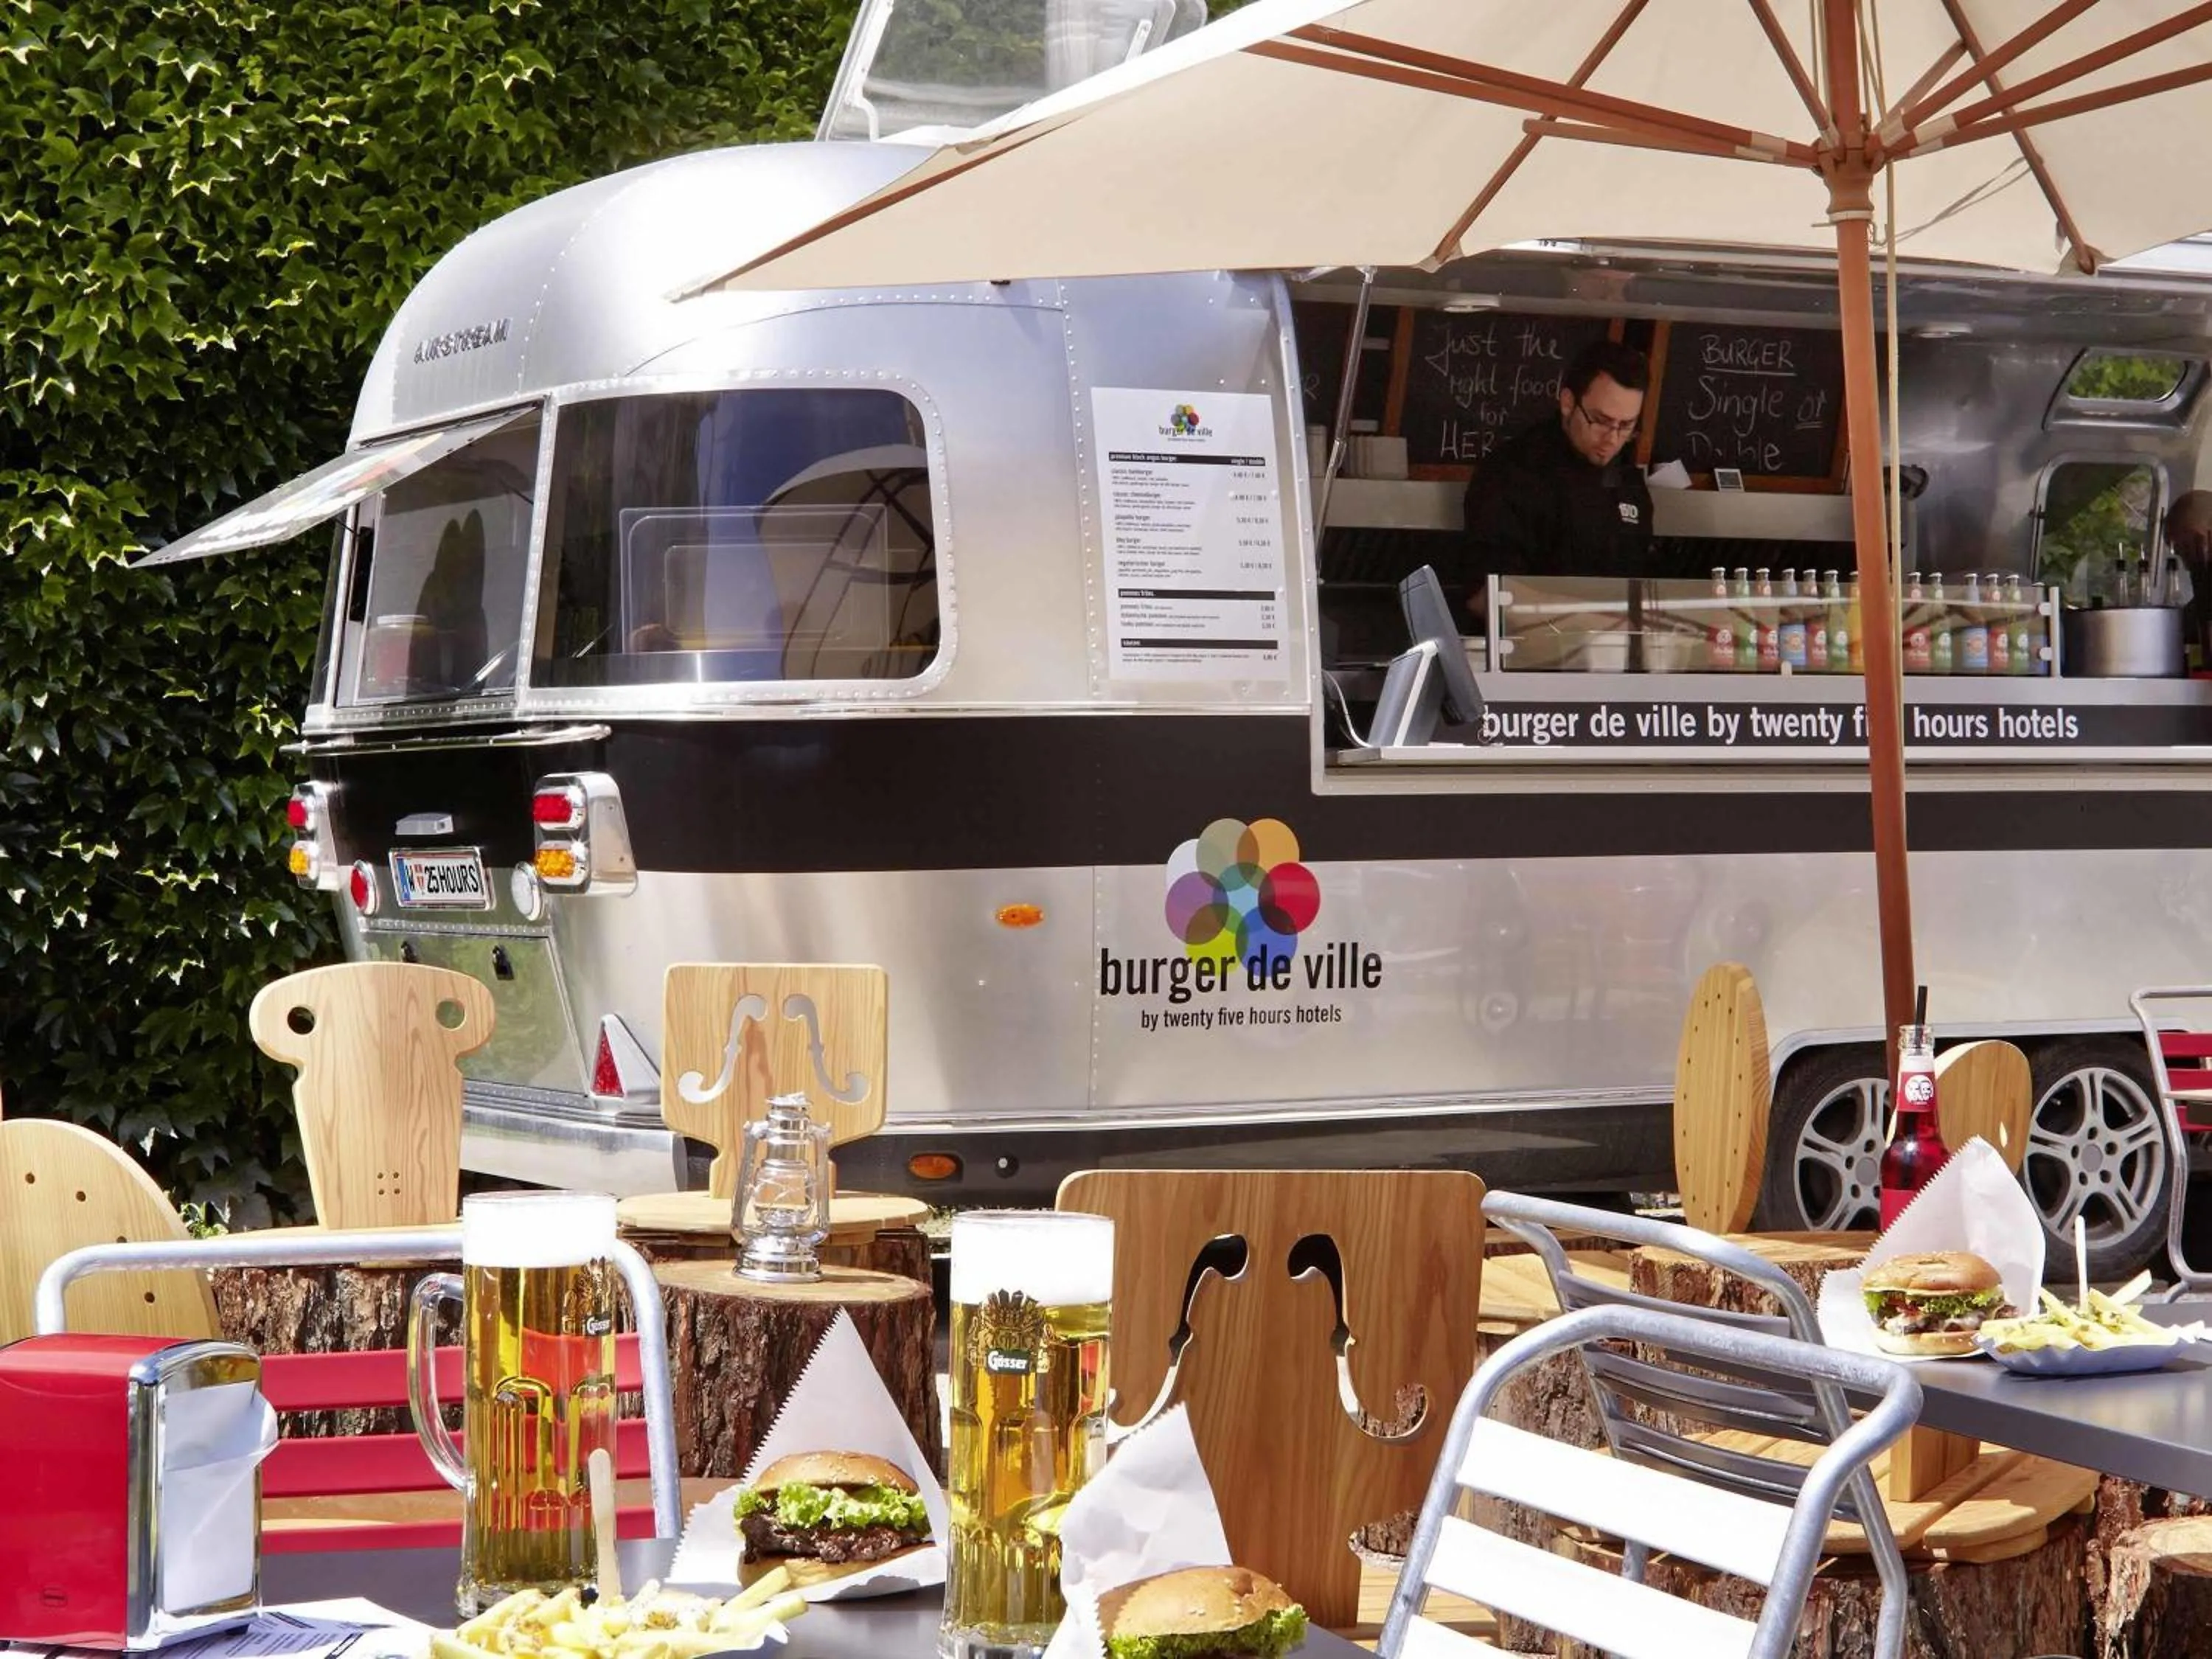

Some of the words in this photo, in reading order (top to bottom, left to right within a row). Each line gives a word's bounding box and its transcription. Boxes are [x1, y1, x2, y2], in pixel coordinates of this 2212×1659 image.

[1425, 322, 1499, 377] Just
[1516, 321, 1564, 360] the
[1699, 334, 1795, 369] BURGER
[1450, 364, 1498, 408] right
[1509, 366, 1564, 406] food
[1688, 375, 1784, 438] Single
[1797, 389, 1828, 423] or
[1482, 704, 1579, 745] burger
[1590, 704, 1626, 738] de
[1635, 704, 1697, 738] ville
[1707, 704, 1742, 745] by
[1750, 706, 1844, 745] twenty
[1913, 706, 1989, 739] hours
[1998, 707, 2079, 739] hotels
[1101, 947, 1236, 1004] burger
[1246, 943, 1292, 992] de
[1304, 942, 1383, 990] ville
[1141, 1009, 1159, 1032] by
[1163, 1009, 1215, 1030] twenty
[1217, 1006, 1245, 1026] five
[1249, 1006, 1292, 1025] hours
[1295, 1004, 1343, 1023] hotels
